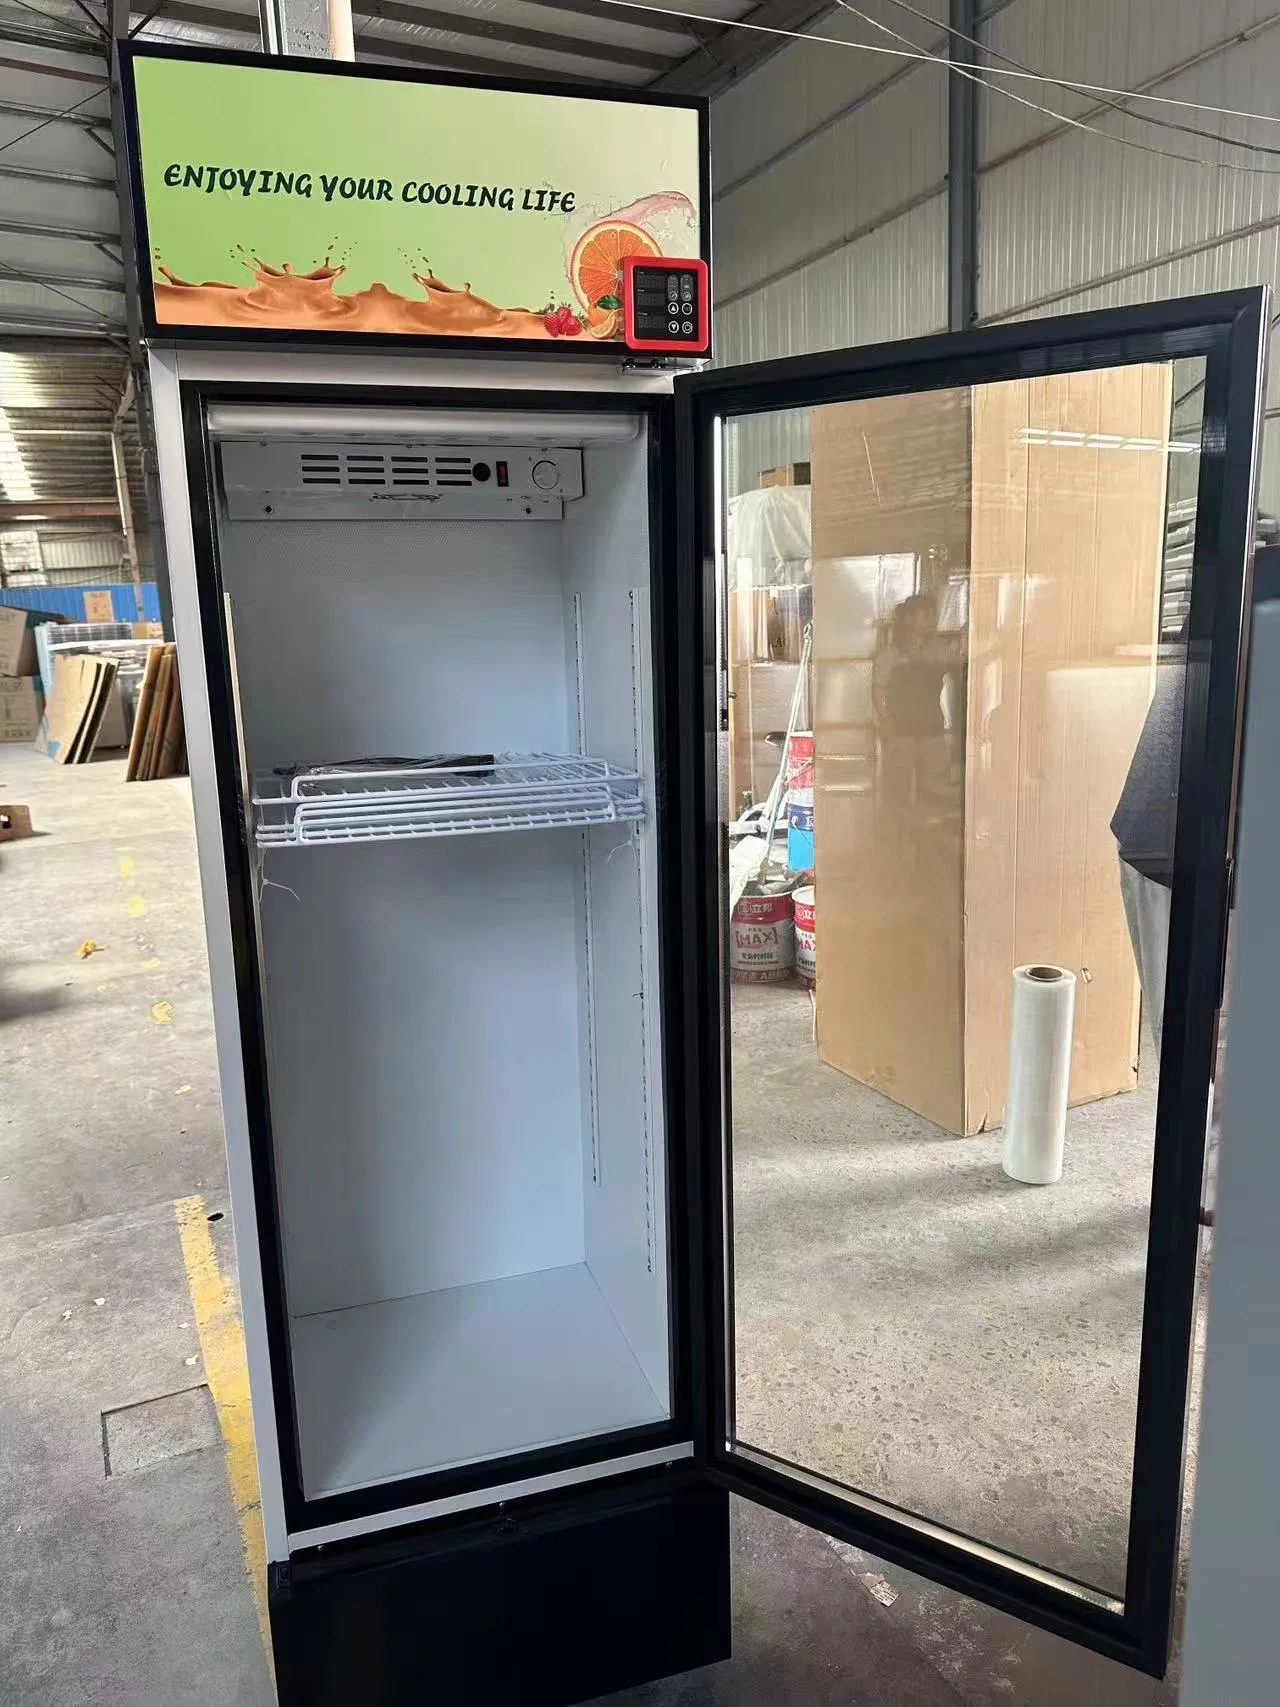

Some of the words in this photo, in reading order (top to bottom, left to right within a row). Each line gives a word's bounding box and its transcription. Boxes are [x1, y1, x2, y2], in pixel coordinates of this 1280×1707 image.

[163, 163, 313, 198] ENJOYING
[318, 173, 394, 202] YOUR
[401, 181, 515, 212] COOLING
[521, 188, 576, 213] LIFE
